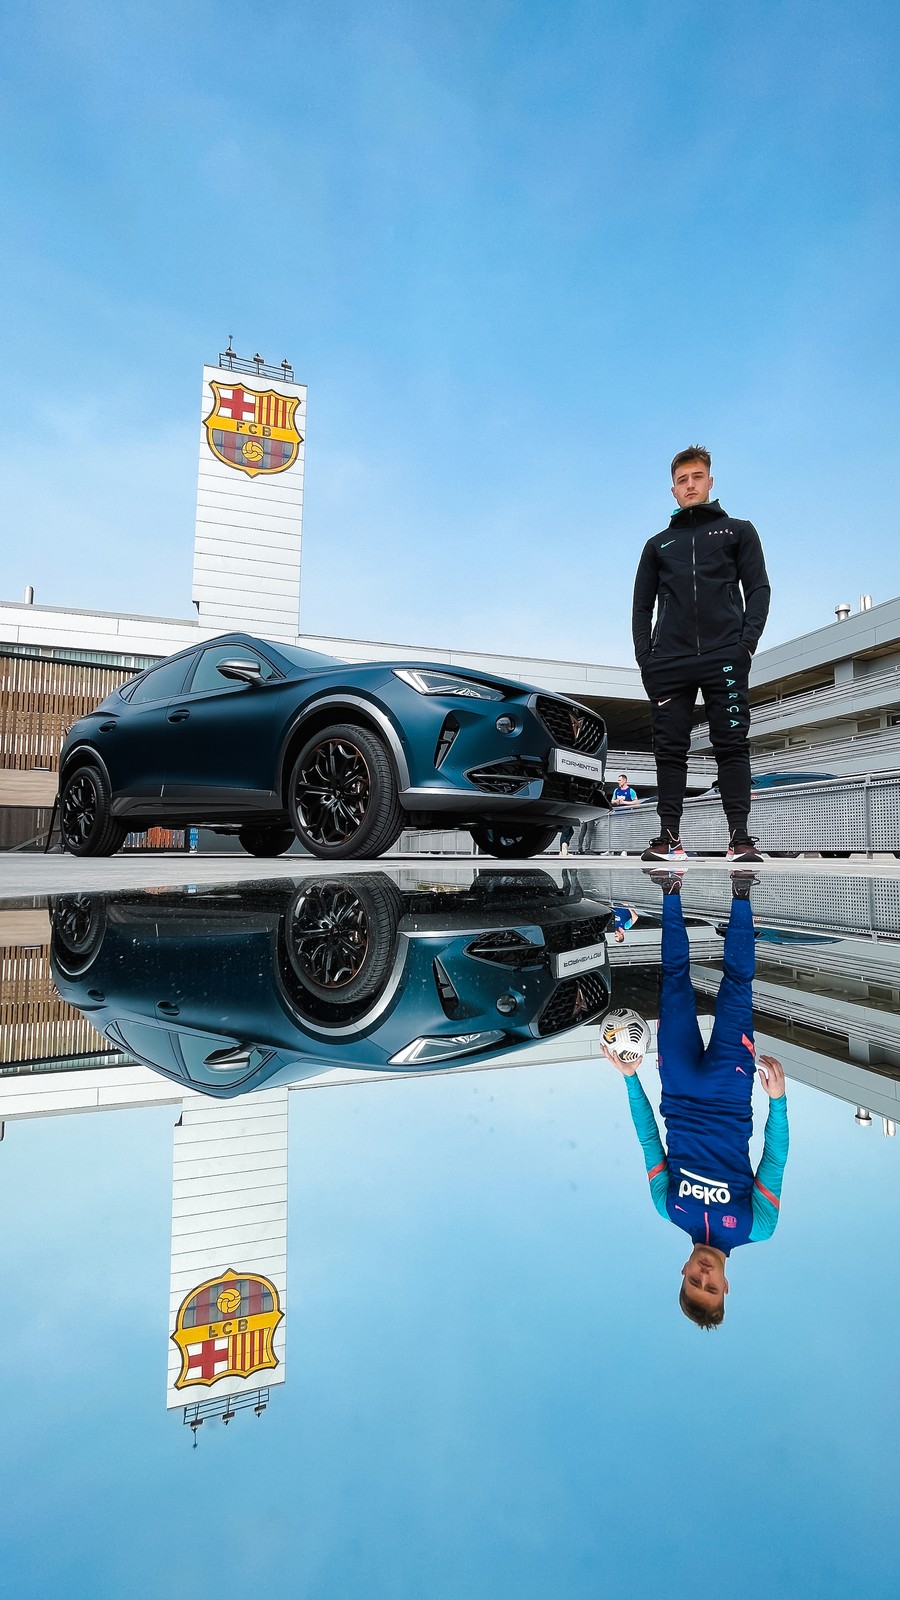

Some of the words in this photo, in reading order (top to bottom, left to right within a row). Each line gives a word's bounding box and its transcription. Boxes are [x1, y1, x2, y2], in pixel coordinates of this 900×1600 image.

[236, 421, 272, 438] FCB
[722, 665, 740, 728] BARÇA
[561, 759, 599, 772] FORMENTOR
